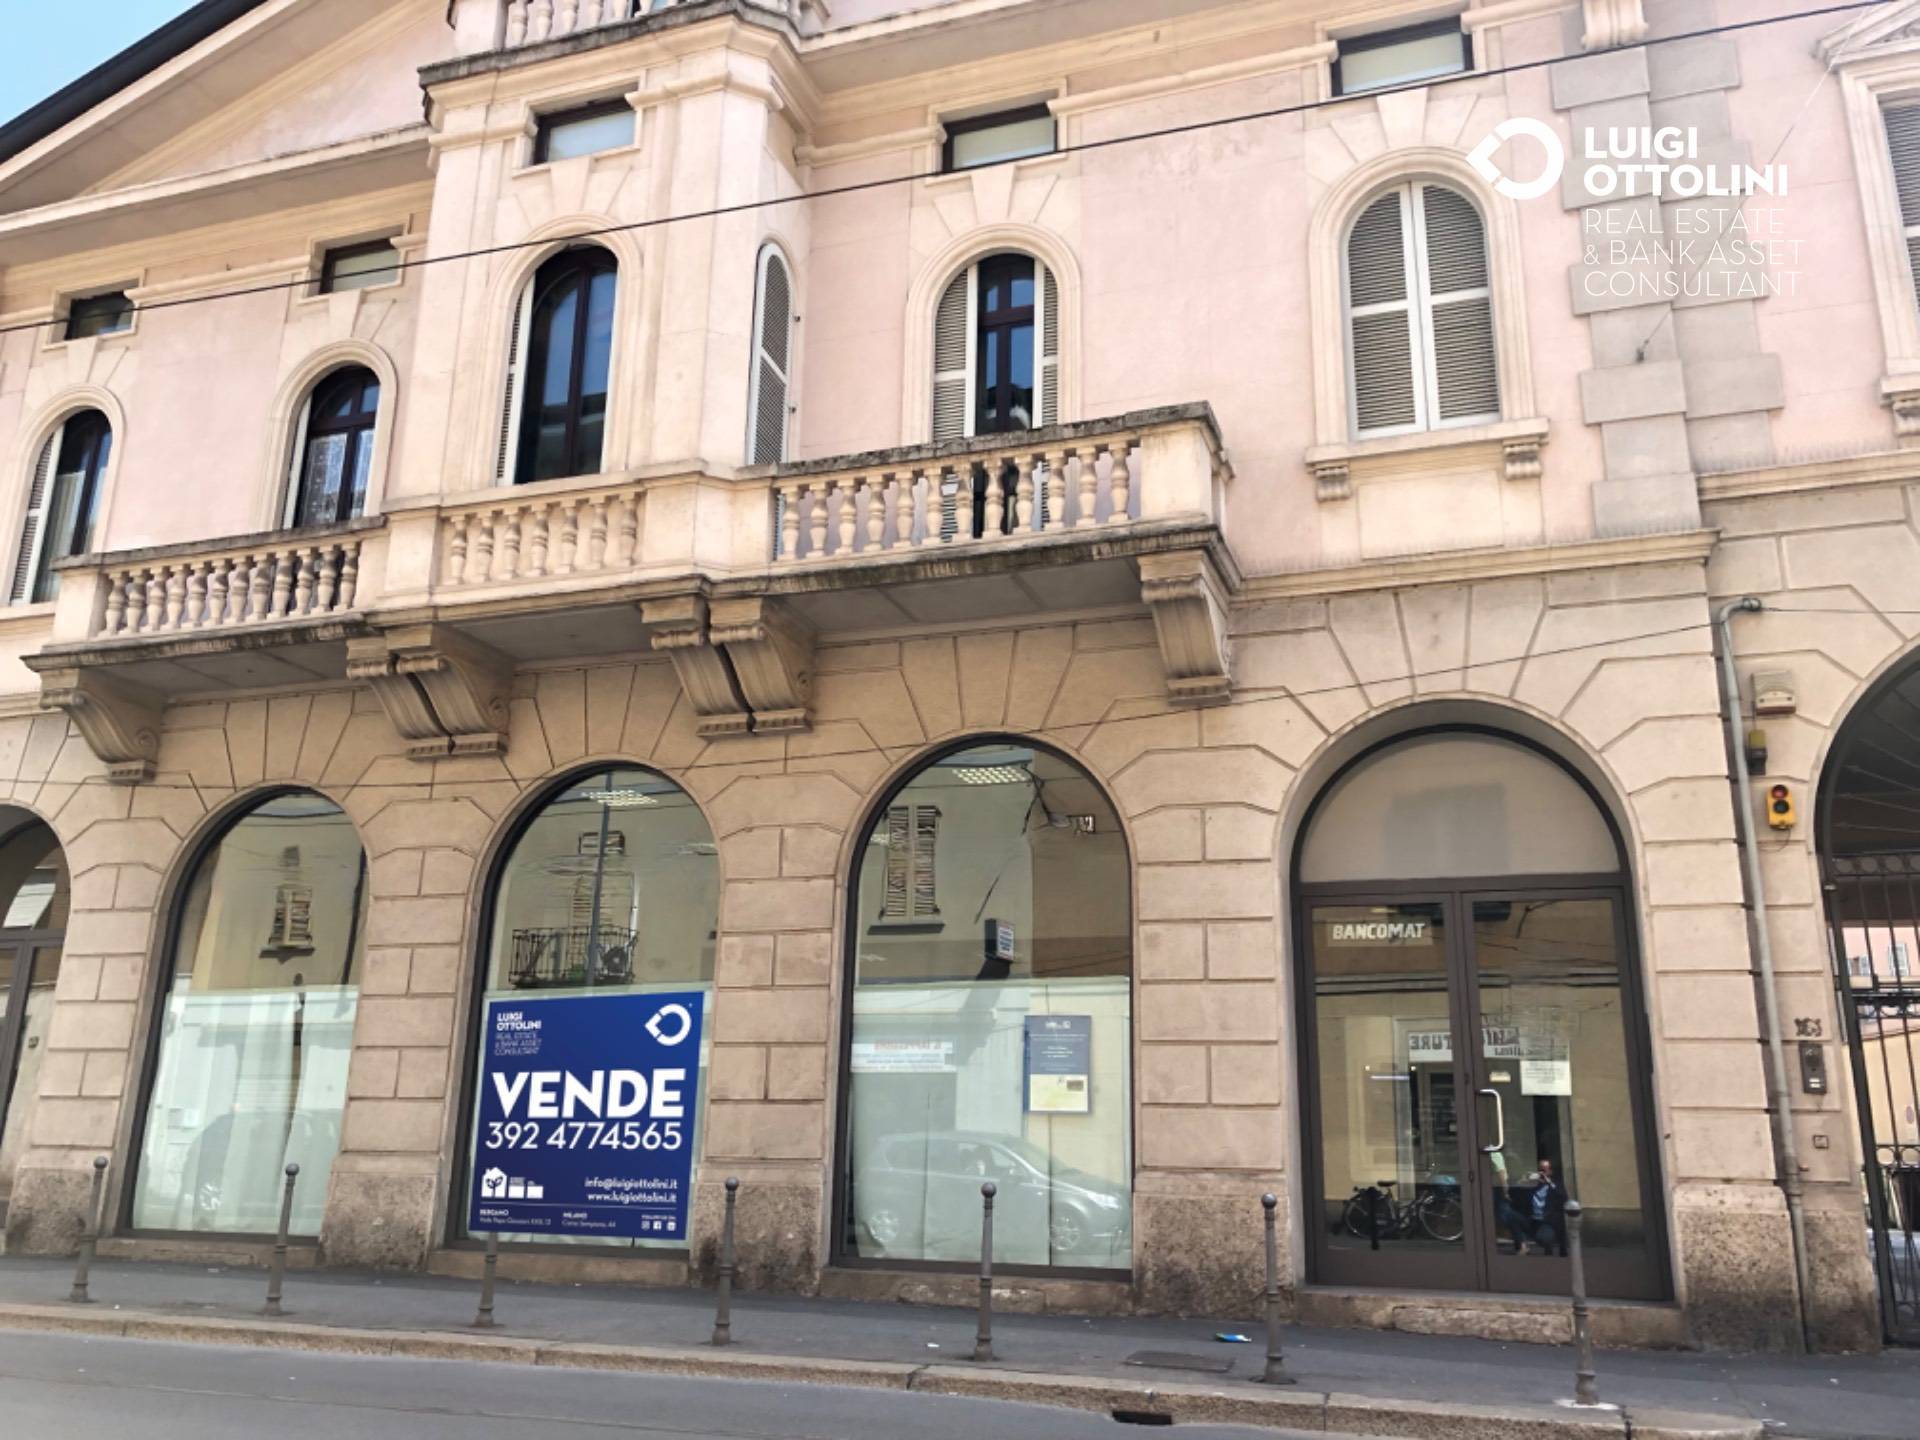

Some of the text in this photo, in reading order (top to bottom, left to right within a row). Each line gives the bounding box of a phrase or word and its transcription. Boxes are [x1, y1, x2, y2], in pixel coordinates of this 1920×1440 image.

[1332, 922, 1427, 941] BANCOMAT
[497, 1011, 523, 1022] LUIGI
[496, 1020, 542, 1031] OTTOLINI
[492, 1068, 686, 1119] VENDE
[485, 1121, 683, 1150] 392 4774565
[584, 1177, 678, 1191] info@luigiottolini.it
[587, 1190, 677, 1205] www.luigiottolini.it
